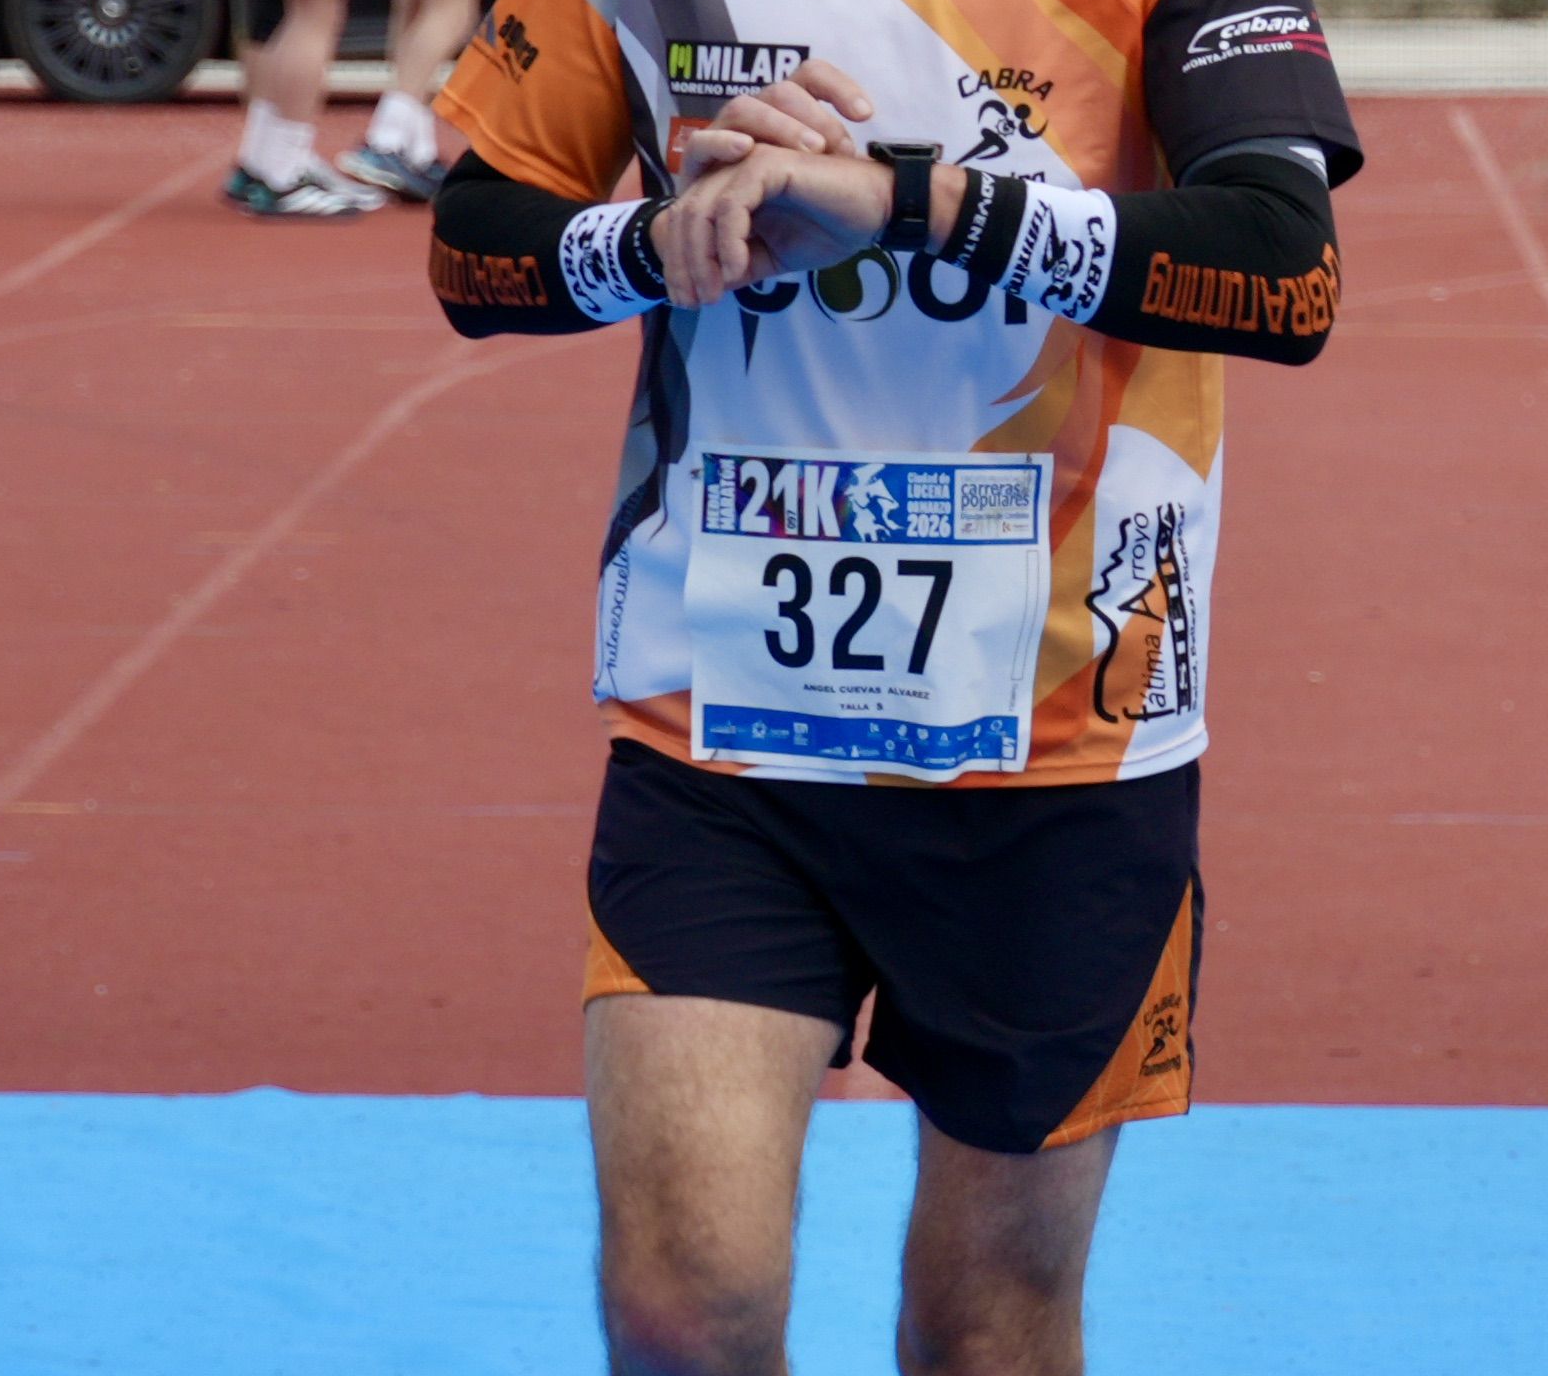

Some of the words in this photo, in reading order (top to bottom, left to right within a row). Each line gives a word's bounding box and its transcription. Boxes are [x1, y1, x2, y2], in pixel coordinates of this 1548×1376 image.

[1219, 16, 1310, 39] cabapé
[696, 44, 802, 84] MILAR
[1182, 44, 1242, 73] MONTAJES
[1243, 41, 1293, 55] ELECTRO
[671, 82, 723, 96] MORENO
[957, 67, 1054, 101] CABRA
[740, 459, 842, 538] 21K
[961, 483, 1021, 496] carreras
[961, 494, 1030, 511] populares
[906, 514, 952, 538] 2026
[762, 553, 953, 675] 327
[804, 683, 836, 694] ANGEL
[839, 686, 882, 695] CUEVAS
[888, 687, 930, 700] ALVAREZ
[840, 703, 870, 711] TALLA
